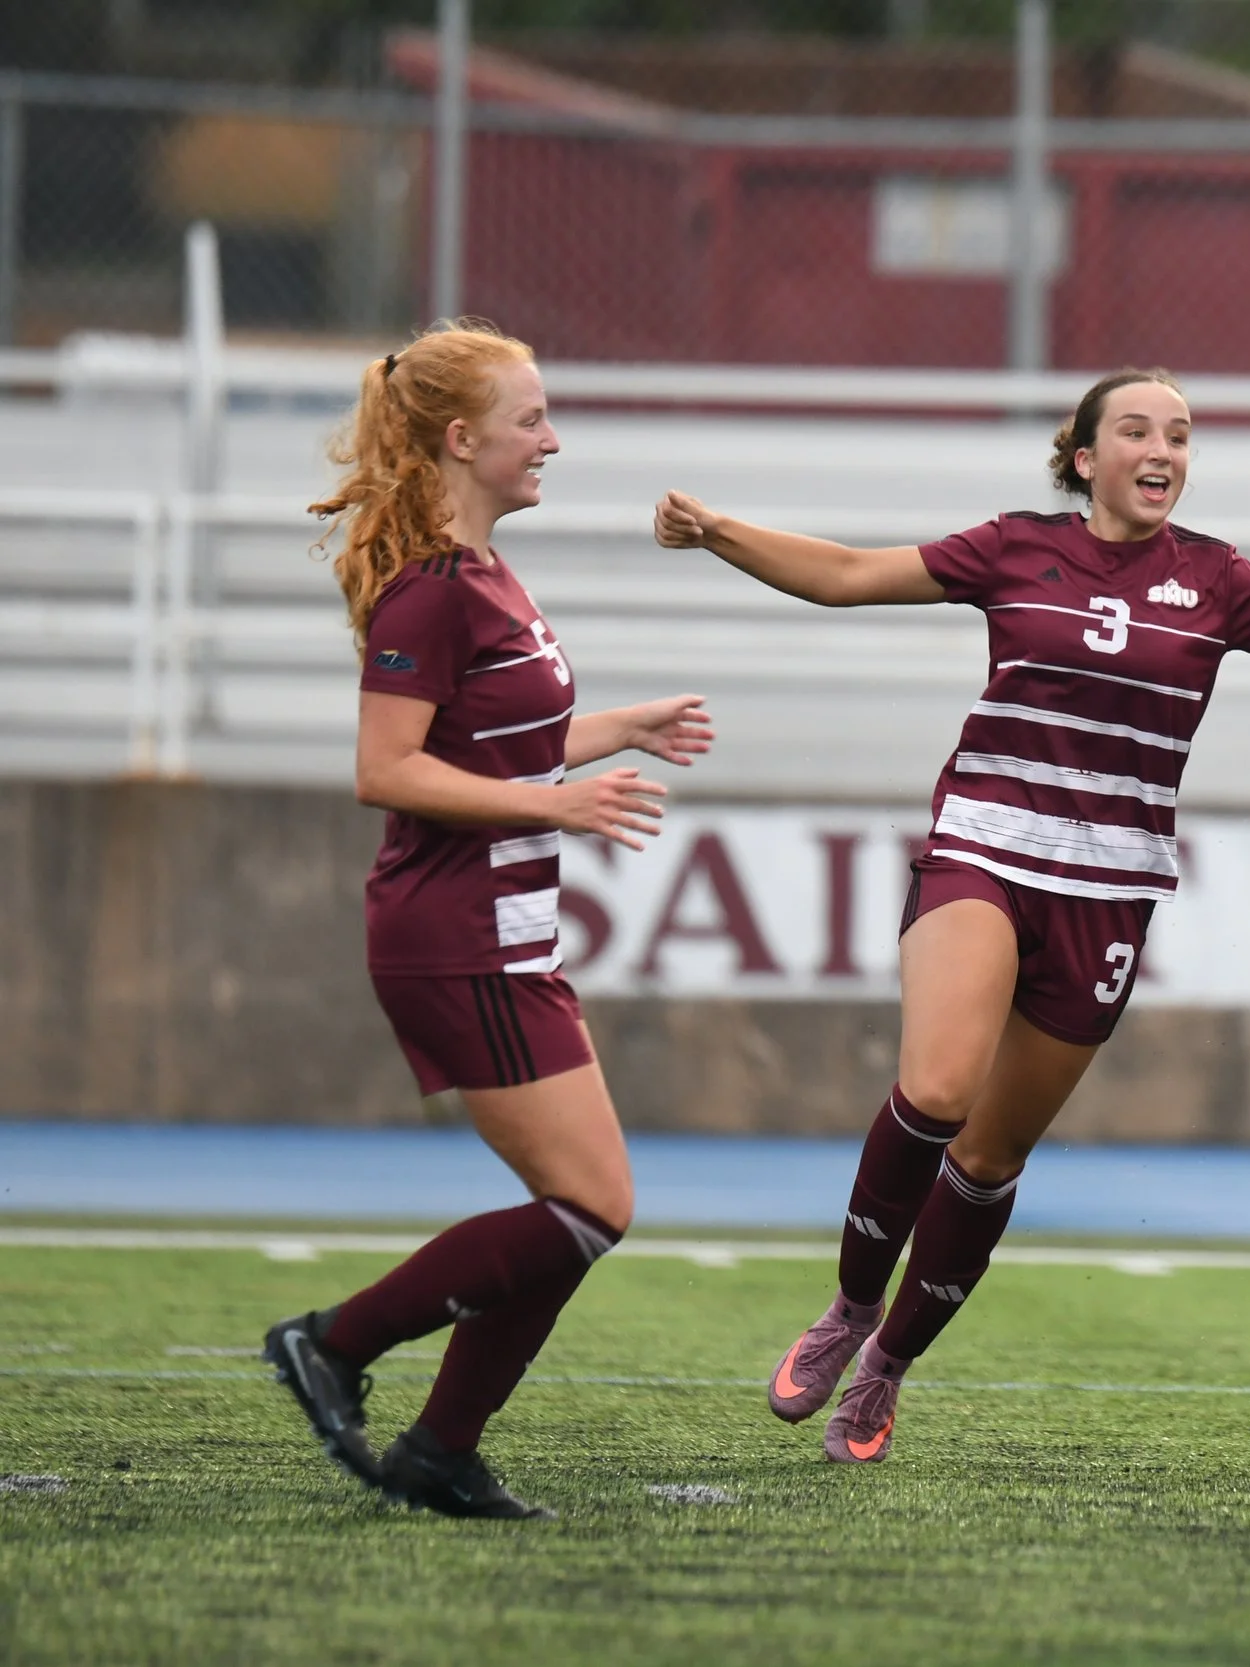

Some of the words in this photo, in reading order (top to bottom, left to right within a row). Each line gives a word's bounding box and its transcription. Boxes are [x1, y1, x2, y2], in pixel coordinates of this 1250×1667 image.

[1147, 578, 1199, 608] SMU
[1083, 596, 1131, 655] 3
[558, 826, 1194, 980] SAI
[1094, 941, 1135, 1004] 3
